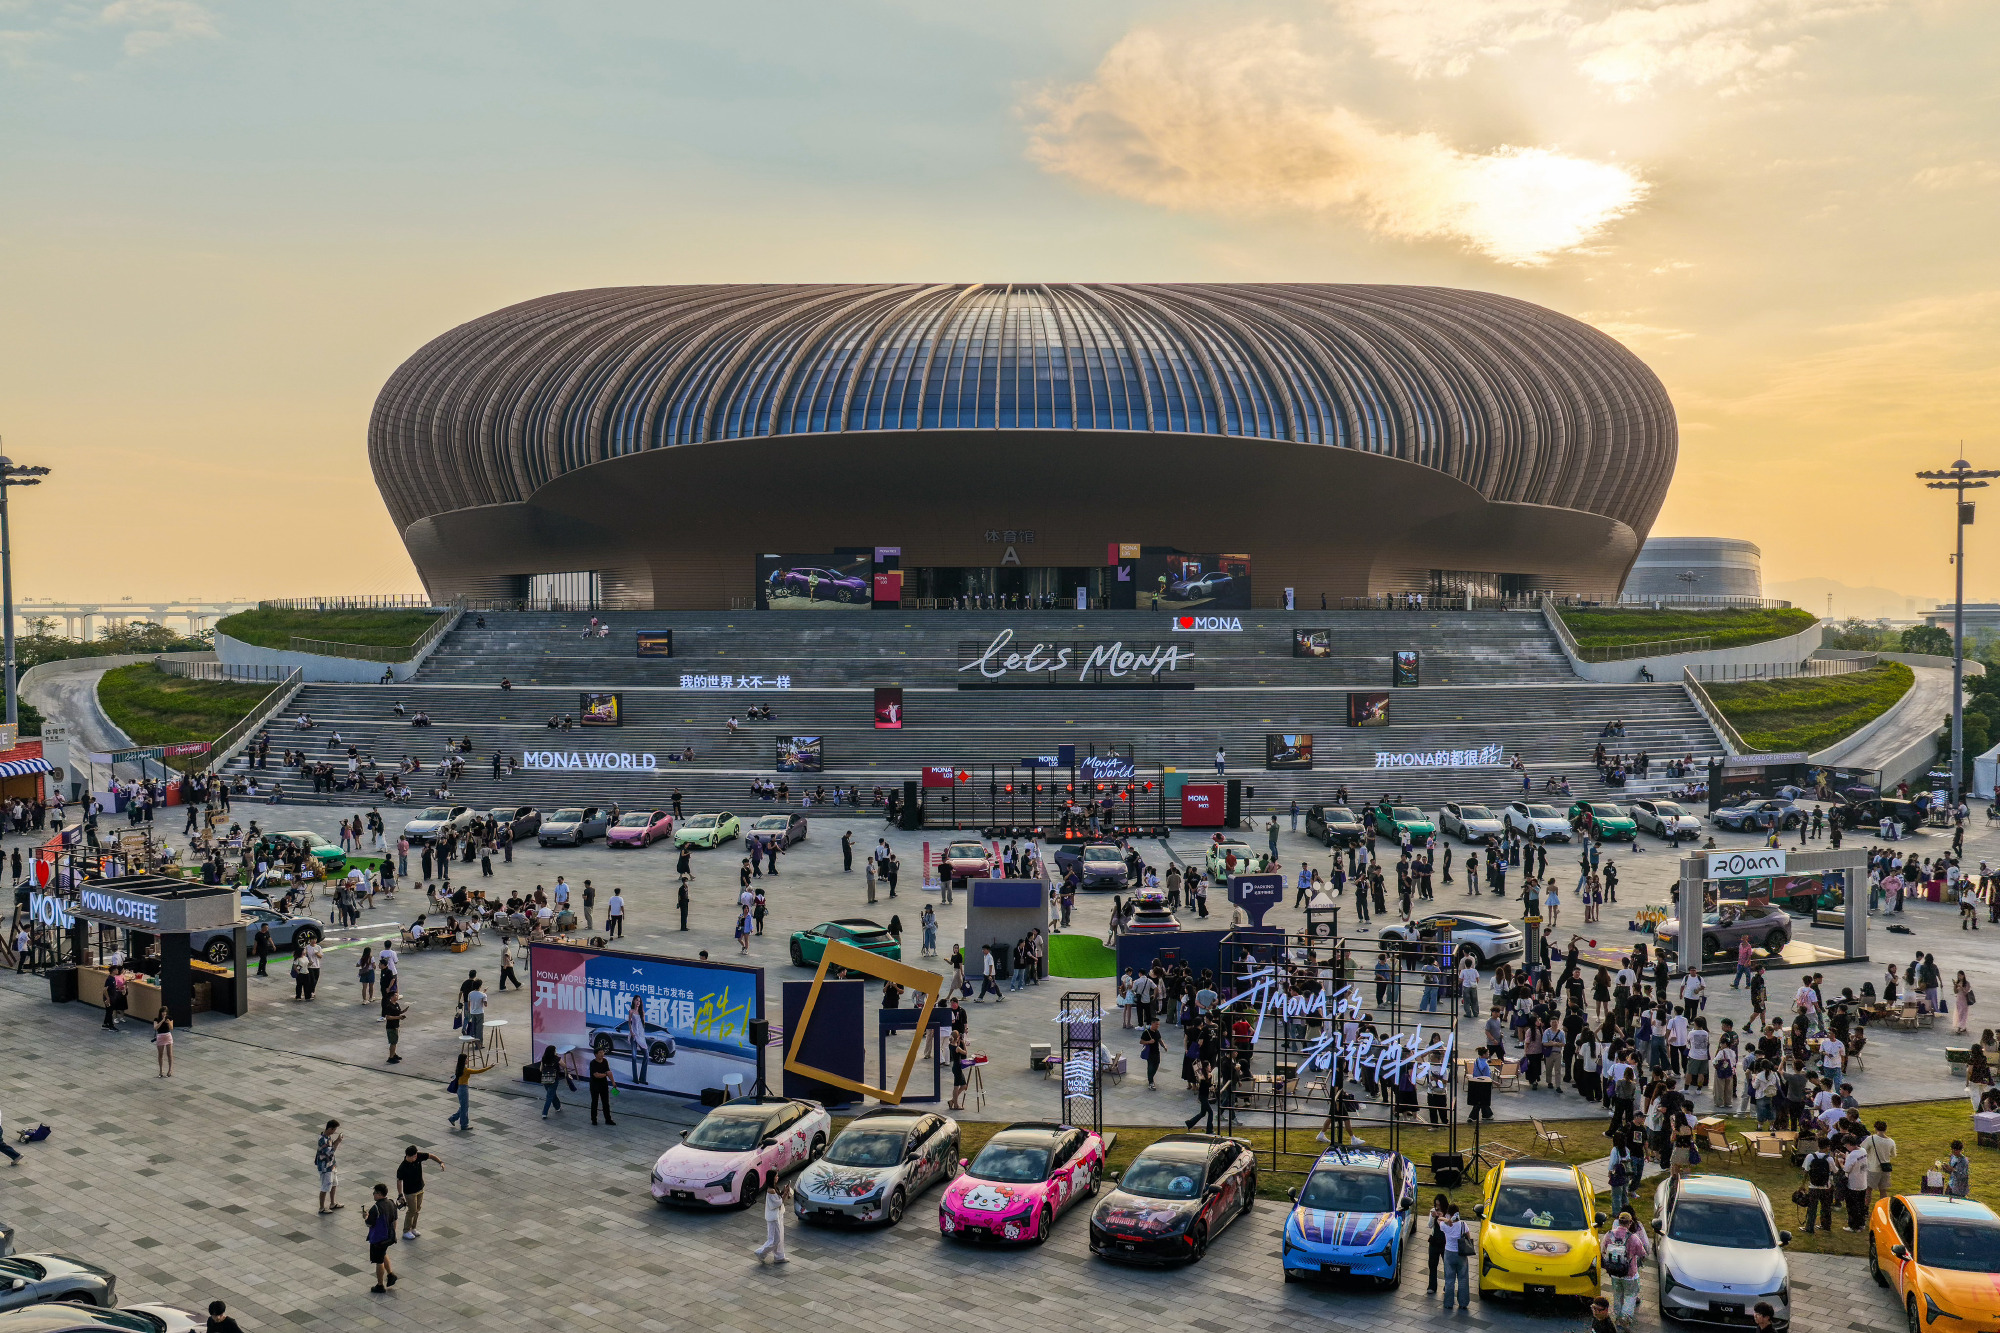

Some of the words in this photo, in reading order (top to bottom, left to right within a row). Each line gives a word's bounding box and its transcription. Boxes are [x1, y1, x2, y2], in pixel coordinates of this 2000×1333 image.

[984, 529, 1035, 544] 体育馆
[1000, 546, 1022, 566] A
[1172, 617, 1179, 630] I
[1195, 616, 1242, 630] MONA
[957, 628, 1072, 678] Let's
[680, 675, 734, 689] 我的世界
[736, 675, 791, 689] 大不一样
[523, 751, 583, 769] MONA
[585, 752, 656, 770] WORLD
[1748, 754, 1766, 762] WORLD
[1773, 752, 1802, 761] DIFFERENCE
[1093, 765, 1136, 780] World
[1242, 882, 1254, 899] P
[29, 891, 77, 930] MONA
[81, 889, 114, 914] MONA
[115, 897, 160, 924] COFFEE
[536, 970, 560, 981] MONA
